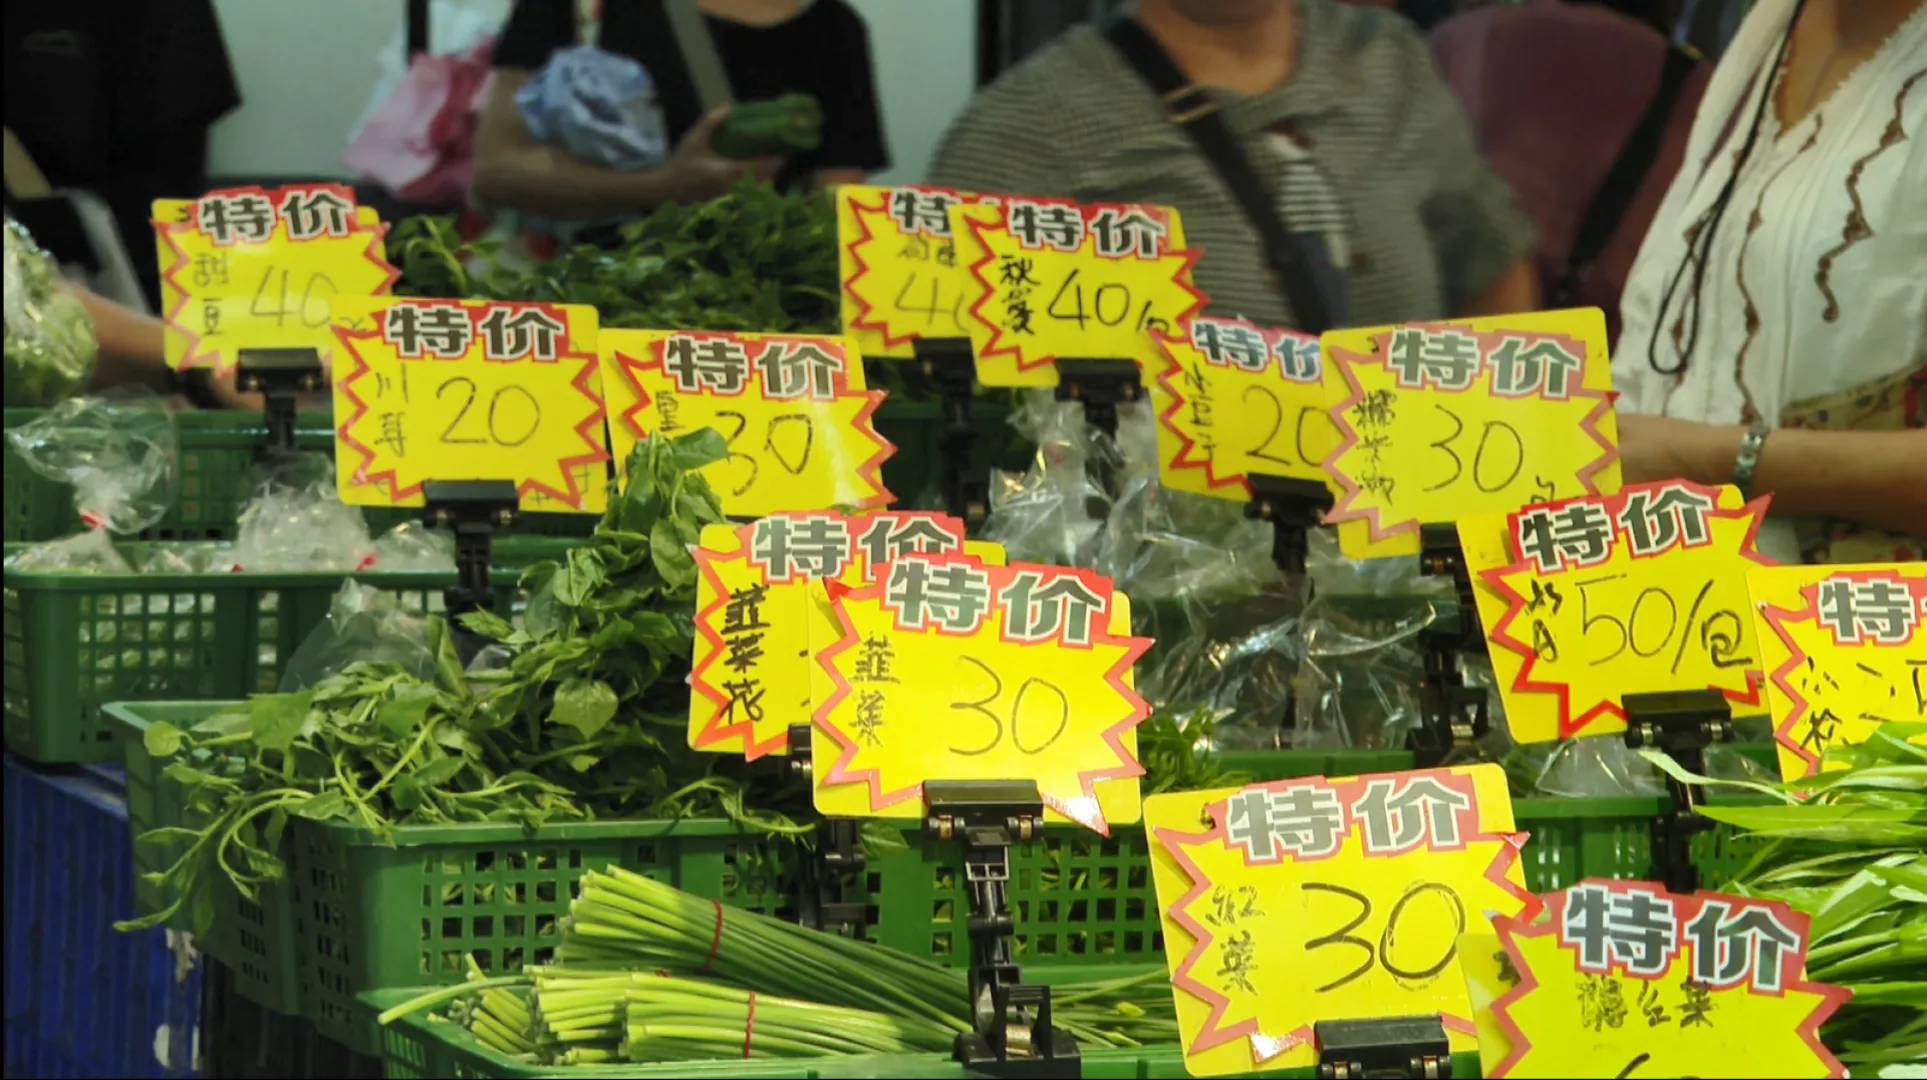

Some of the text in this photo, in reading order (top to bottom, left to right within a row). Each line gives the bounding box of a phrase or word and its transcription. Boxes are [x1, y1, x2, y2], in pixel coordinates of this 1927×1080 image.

[200, 188, 354, 245] 特价
[1007, 200, 1166, 259] 特价
[251, 264, 338, 328] 40
[385, 303, 565, 360] 特价
[663, 334, 843, 399] 特价
[1388, 326, 1581, 399] 特价
[436, 376, 540, 447] 20
[714, 410, 812, 496] 30
[1242, 384, 1333, 467] 20
[1422, 403, 1524, 493] 30
[1518, 484, 1713, 572] 特价
[886, 557, 1106, 645] 特价
[1574, 573, 1753, 676] 50/包
[1818, 577, 1926, 643] 特
[719, 582, 771, 725] 韭菜花
[848, 631, 901, 748] 韭菜
[948, 654, 1068, 757] 30
[1225, 776, 1470, 862] 特价
[1301, 879, 1467, 994] 30
[1562, 883, 1801, 992] 特价
